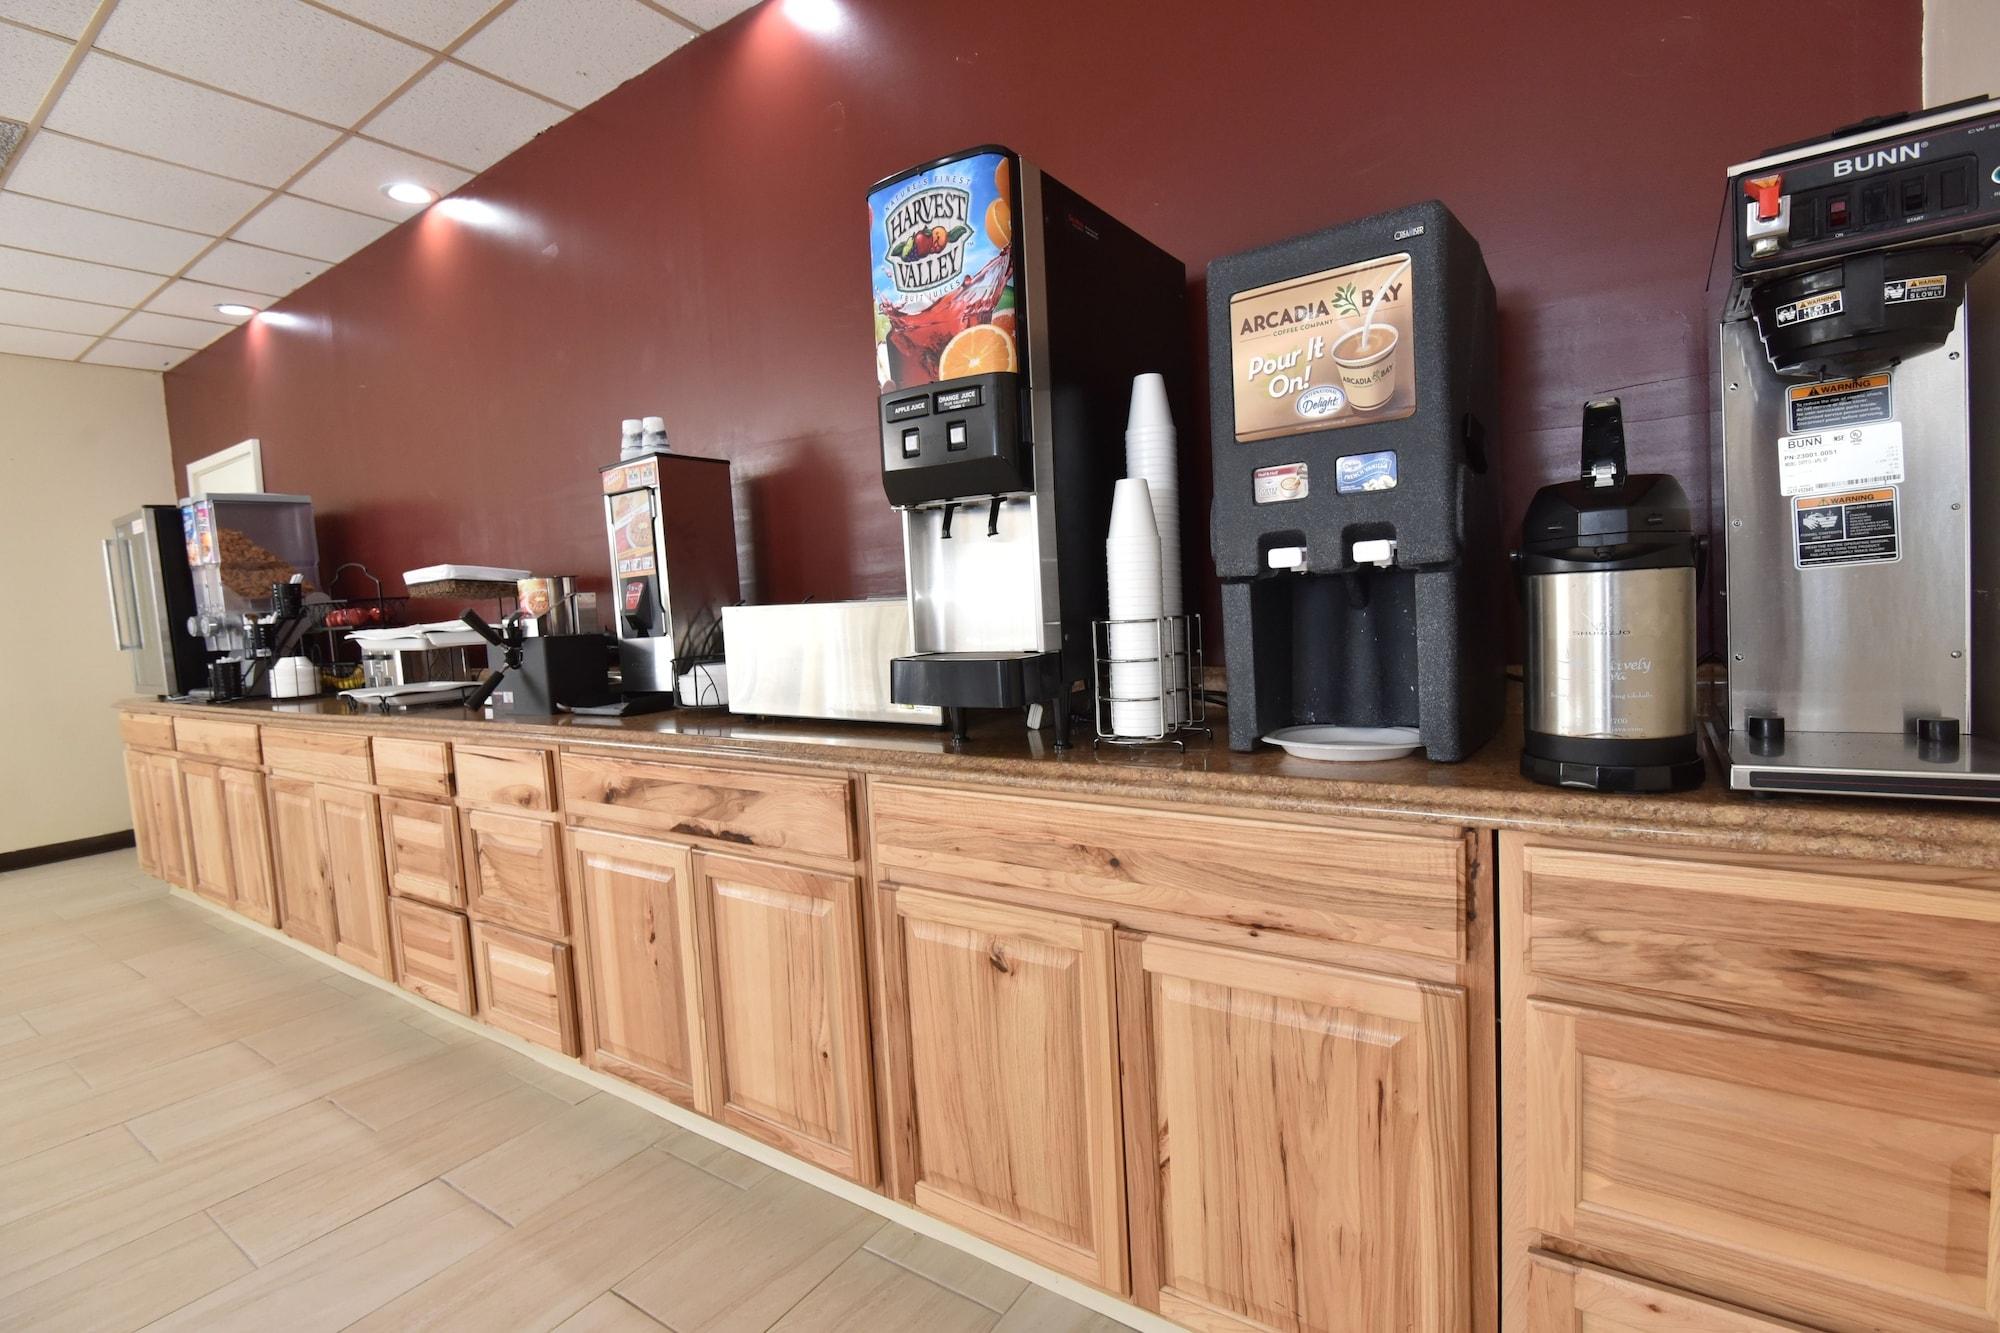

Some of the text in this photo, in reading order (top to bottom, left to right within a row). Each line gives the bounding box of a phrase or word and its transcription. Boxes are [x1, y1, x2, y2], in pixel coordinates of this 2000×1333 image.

[934, 175, 971, 186] FINEST
[890, 192, 966, 243] HARVEST
[898, 247, 958, 288] VALLEY
[929, 279, 962, 299] JUICES
[1910, 290, 1942, 298] SLOWLY
[1240, 282, 1402, 336] ARCADIA BAY
[1803, 302, 1833, 314] HOT
[1273, 318, 1334, 337] COFFEE COMPANY
[1248, 335, 1324, 380] Pour It
[1268, 366, 1311, 399] On!
[1343, 376, 1372, 385] ARCADIA
[1820, 379, 1871, 395] WARNING
[938, 390, 975, 403] ORANGE JUICE
[894, 402, 925, 414] APPLE JUICE
[1302, 396, 1338, 414] Delight
[1788, 437, 1822, 449] BUNN
[1830, 493, 1875, 504] WARNING
